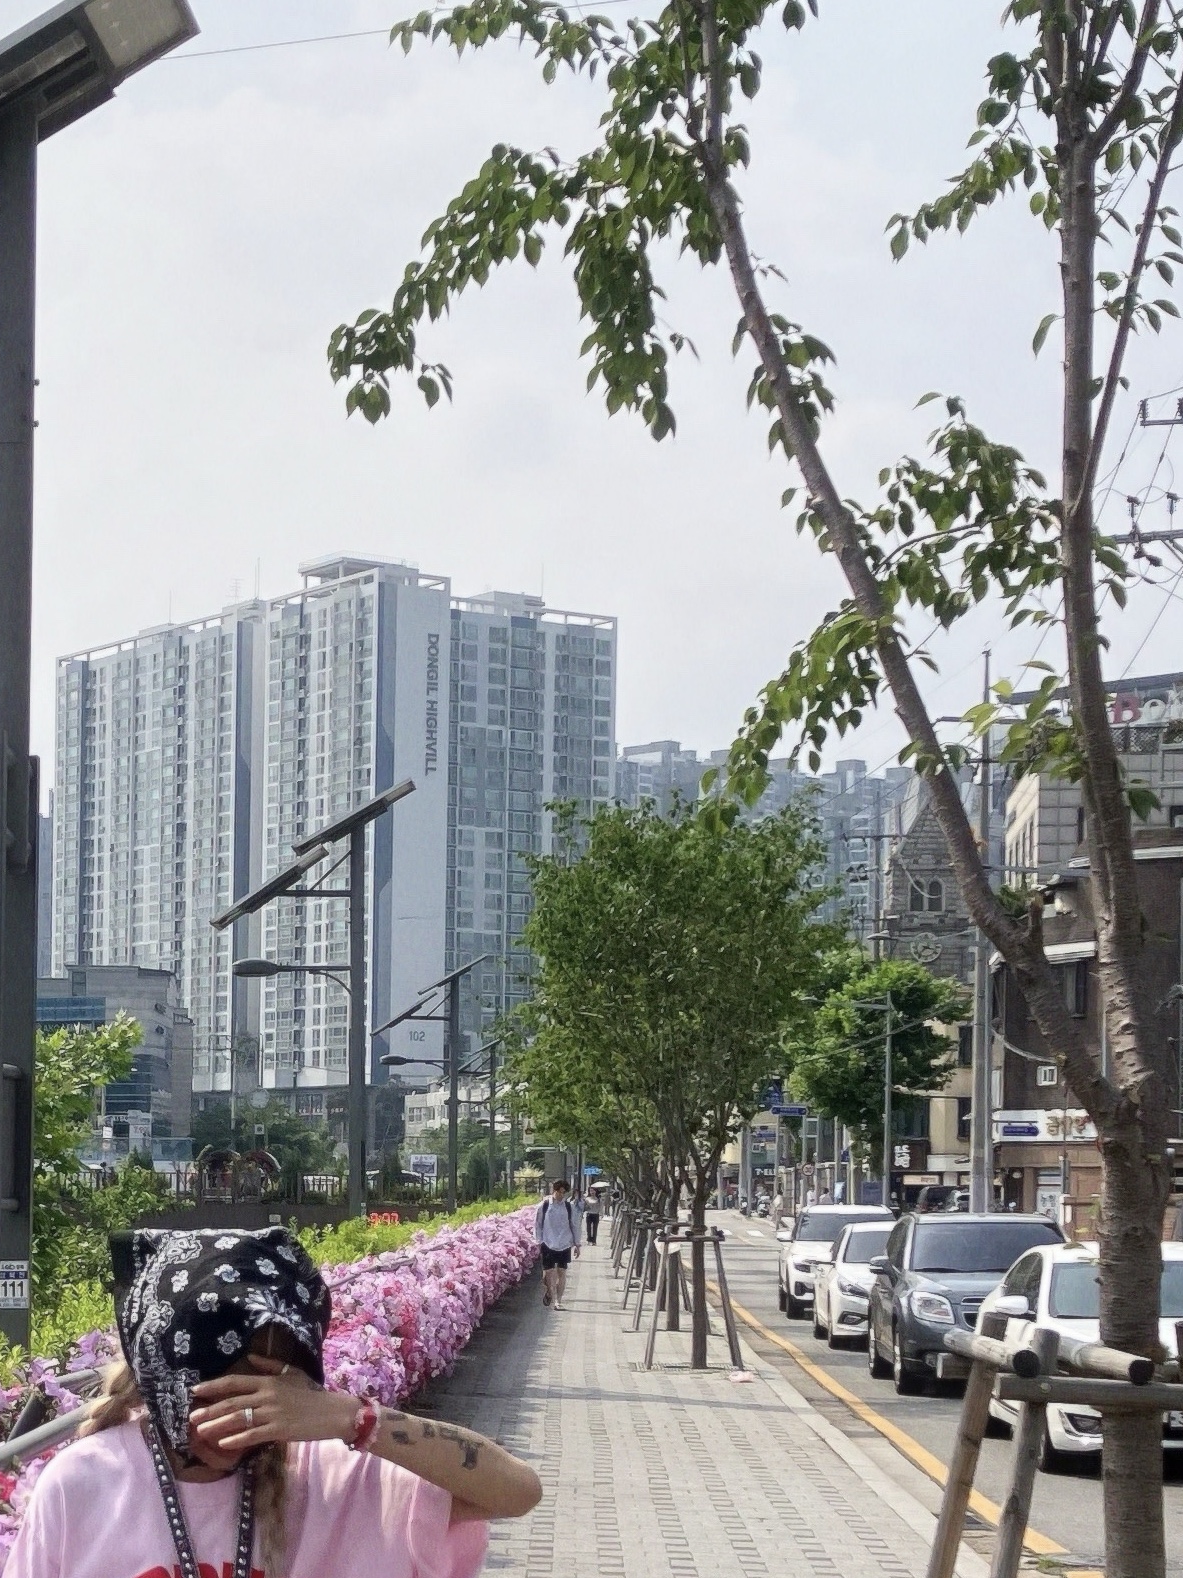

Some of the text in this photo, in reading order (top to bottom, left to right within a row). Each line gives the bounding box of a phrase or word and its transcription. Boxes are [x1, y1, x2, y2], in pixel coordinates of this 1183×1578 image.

[425, 633, 439, 776] DONGIL HIGHVILL
[409, 1031, 425, 1041] 102
[1, 1281, 23, 1297] 111
